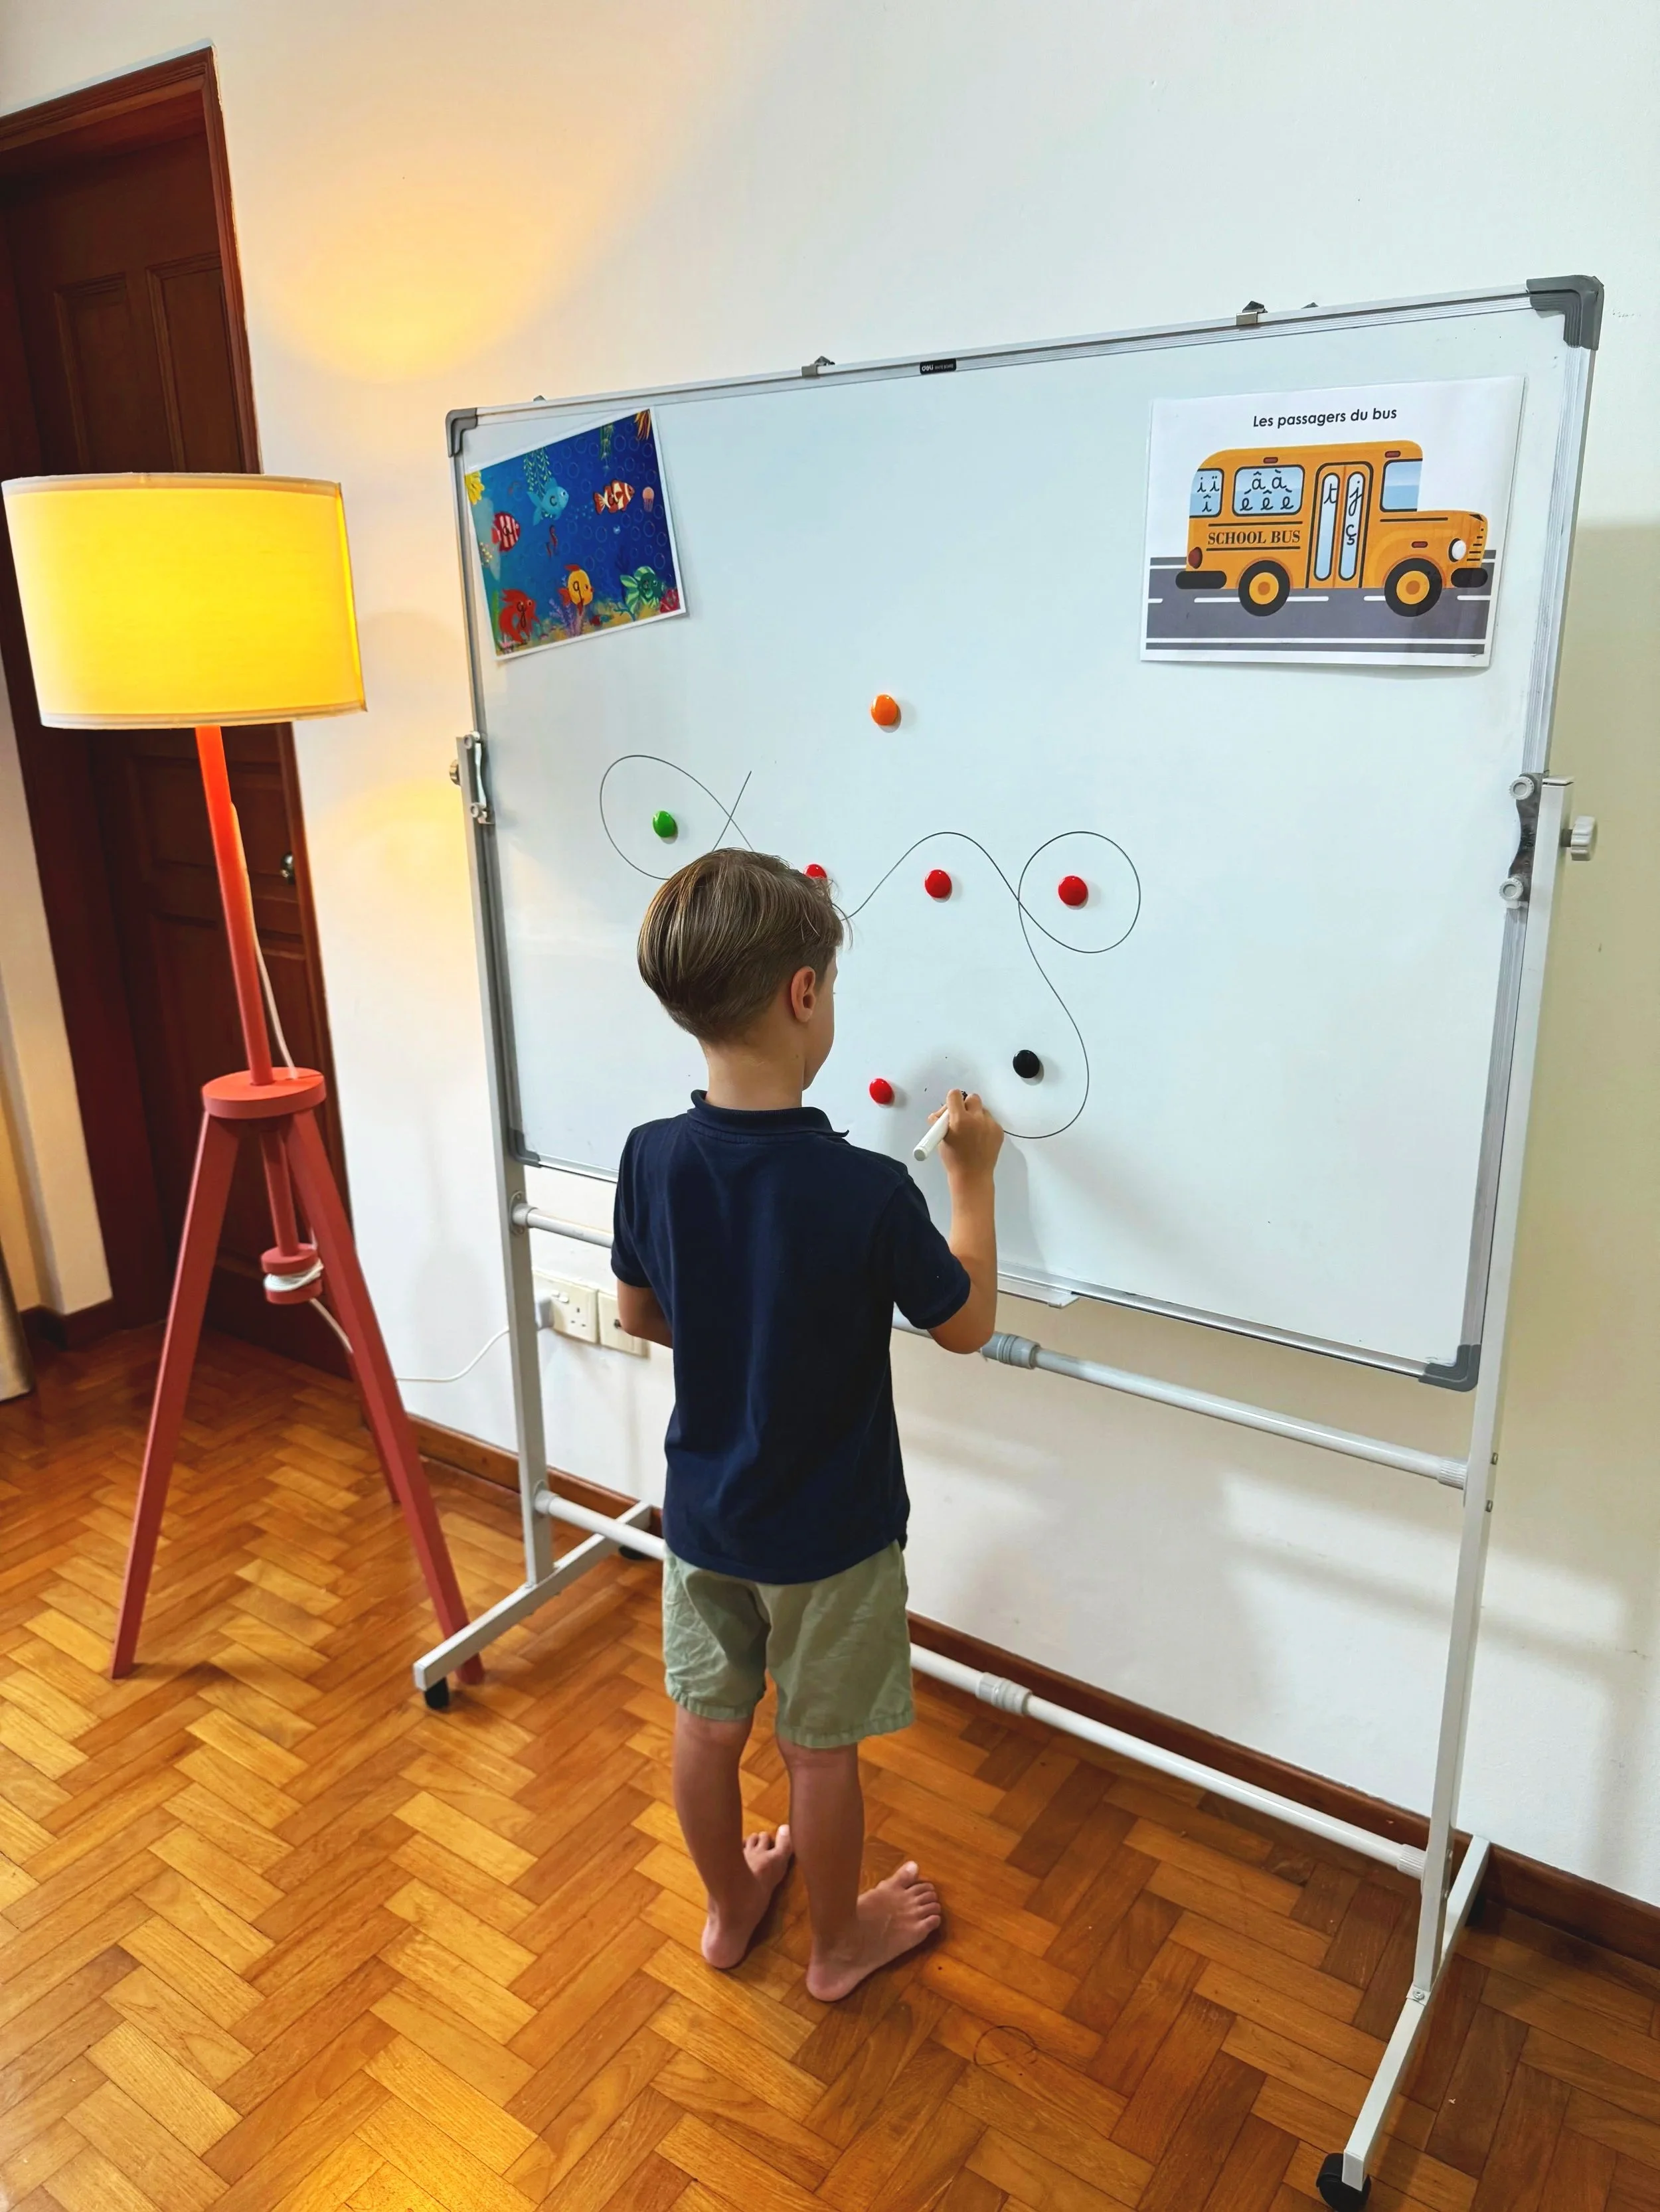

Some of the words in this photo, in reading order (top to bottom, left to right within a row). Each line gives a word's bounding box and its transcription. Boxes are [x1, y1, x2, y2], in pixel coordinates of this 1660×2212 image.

[1253, 416, 1274, 428] Les
[1278, 412, 1346, 429] passagers
[1351, 409, 1368, 422] du
[1372, 408, 1397, 420] bus
[1208, 531, 1266, 545] SCHOOL
[1270, 530, 1301, 544] BUS
